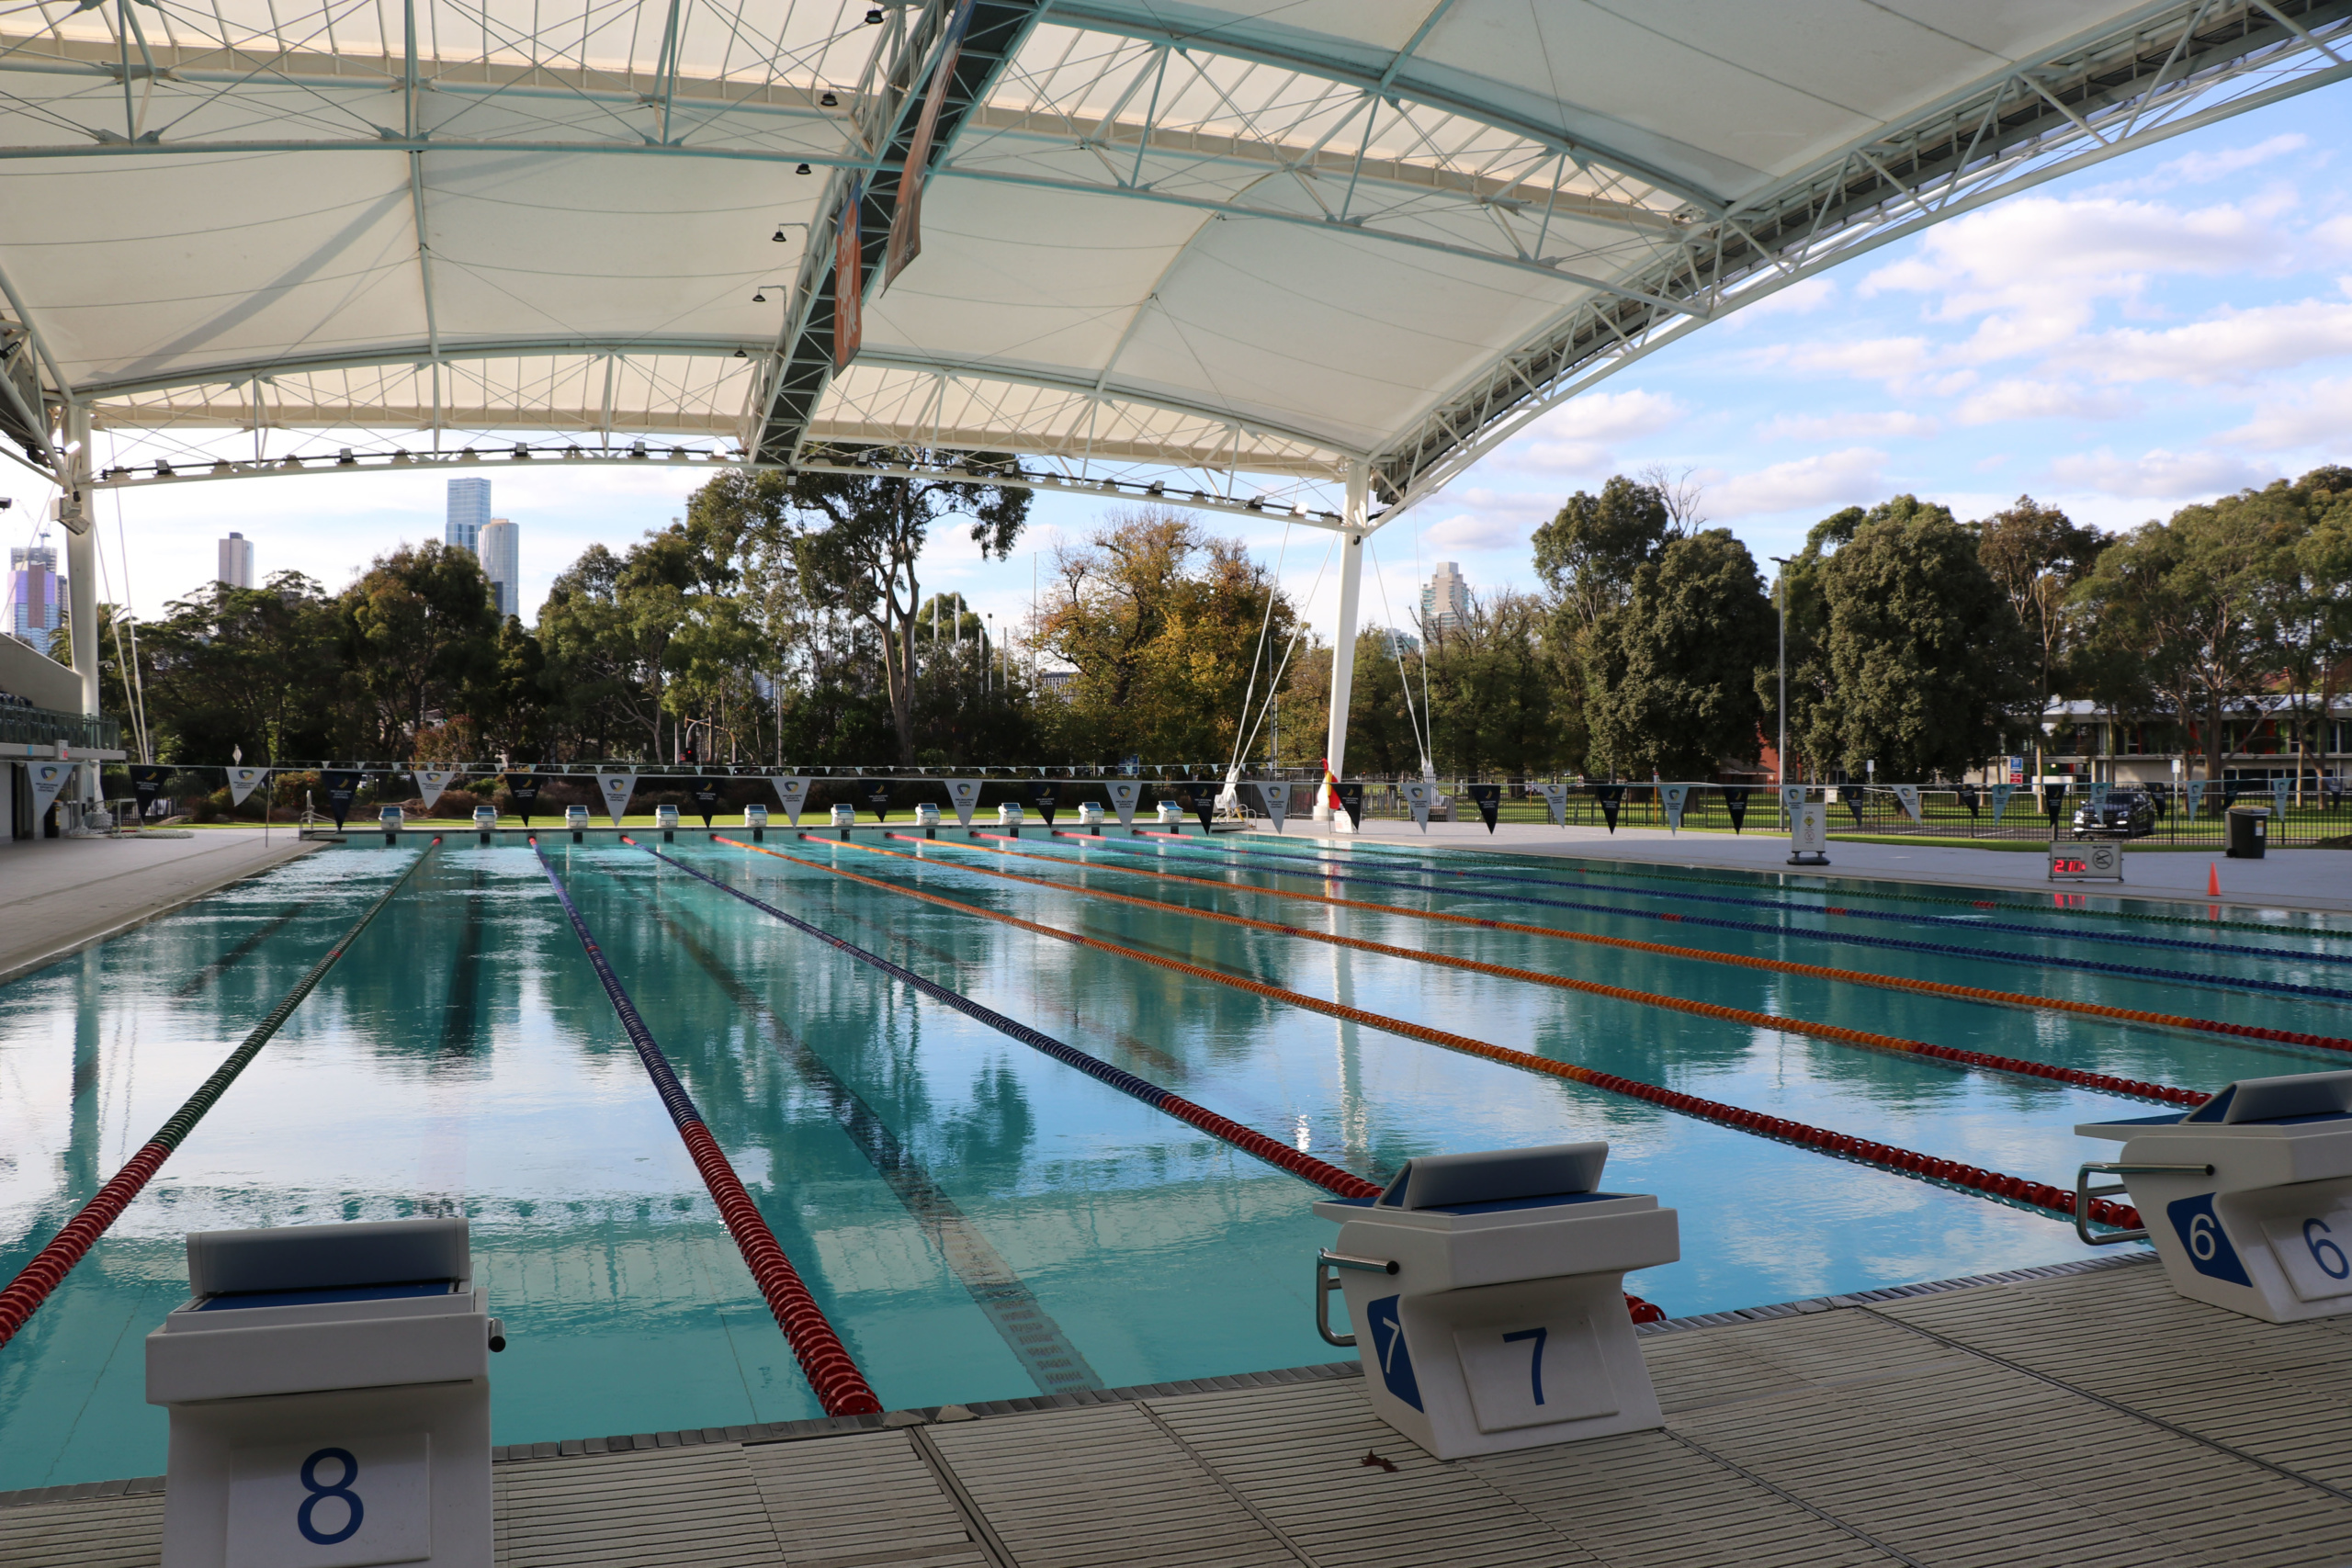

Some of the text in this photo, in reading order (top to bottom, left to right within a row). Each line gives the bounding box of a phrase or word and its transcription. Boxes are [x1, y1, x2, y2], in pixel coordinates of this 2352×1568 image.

[2189, 1213, 2216, 1260] 6
[2302, 1217, 2350, 1280] 6
[1383, 1316, 1400, 1375] 7
[1502, 1326, 1547, 1405] 7
[297, 1447, 364, 1545] 8
